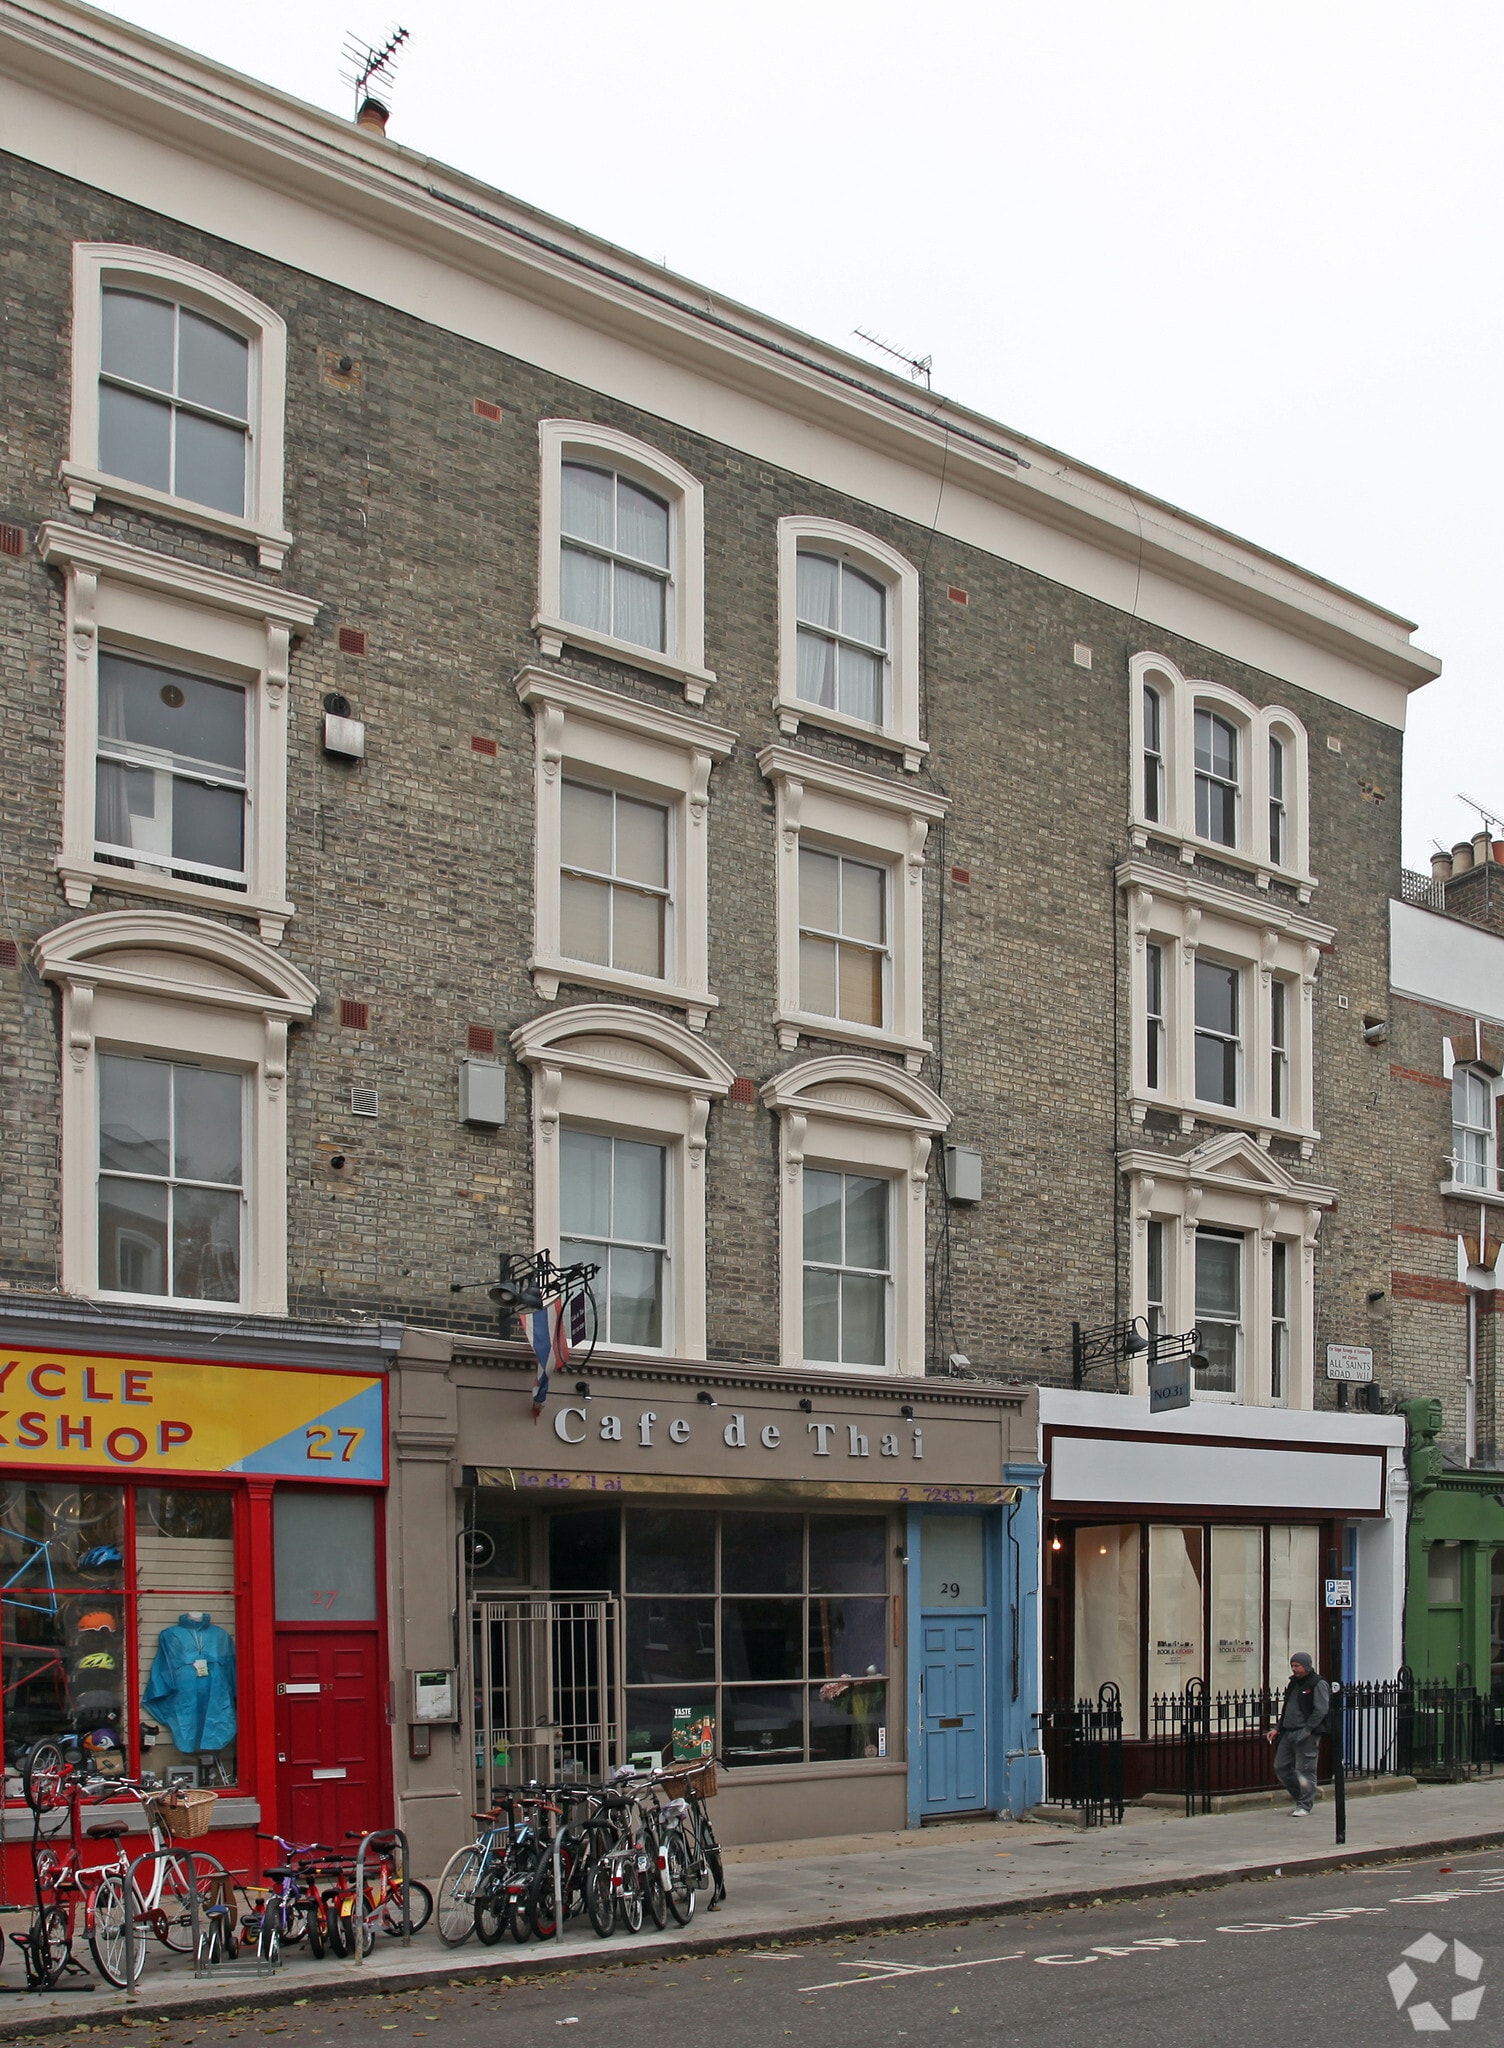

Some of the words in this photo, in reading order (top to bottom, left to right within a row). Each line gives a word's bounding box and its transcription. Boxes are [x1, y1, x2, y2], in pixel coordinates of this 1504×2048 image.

[1330, 1359, 1342, 1368] ALL
[1345, 1360, 1371, 1371] SAINTS
[1330, 1370, 1350, 1378] ROAD
[553, 1407, 692, 1447] Cafe
[723, 1413, 783, 1449] de
[807, 1422, 925, 1459] Thai
[305, 1425, 366, 1462] 27
[311, 1590, 339, 1609] 27
[940, 1583, 960, 1599] 29
[674, 1708, 692, 1716] TASTE
[1034, 1937, 1207, 1965] CAR
